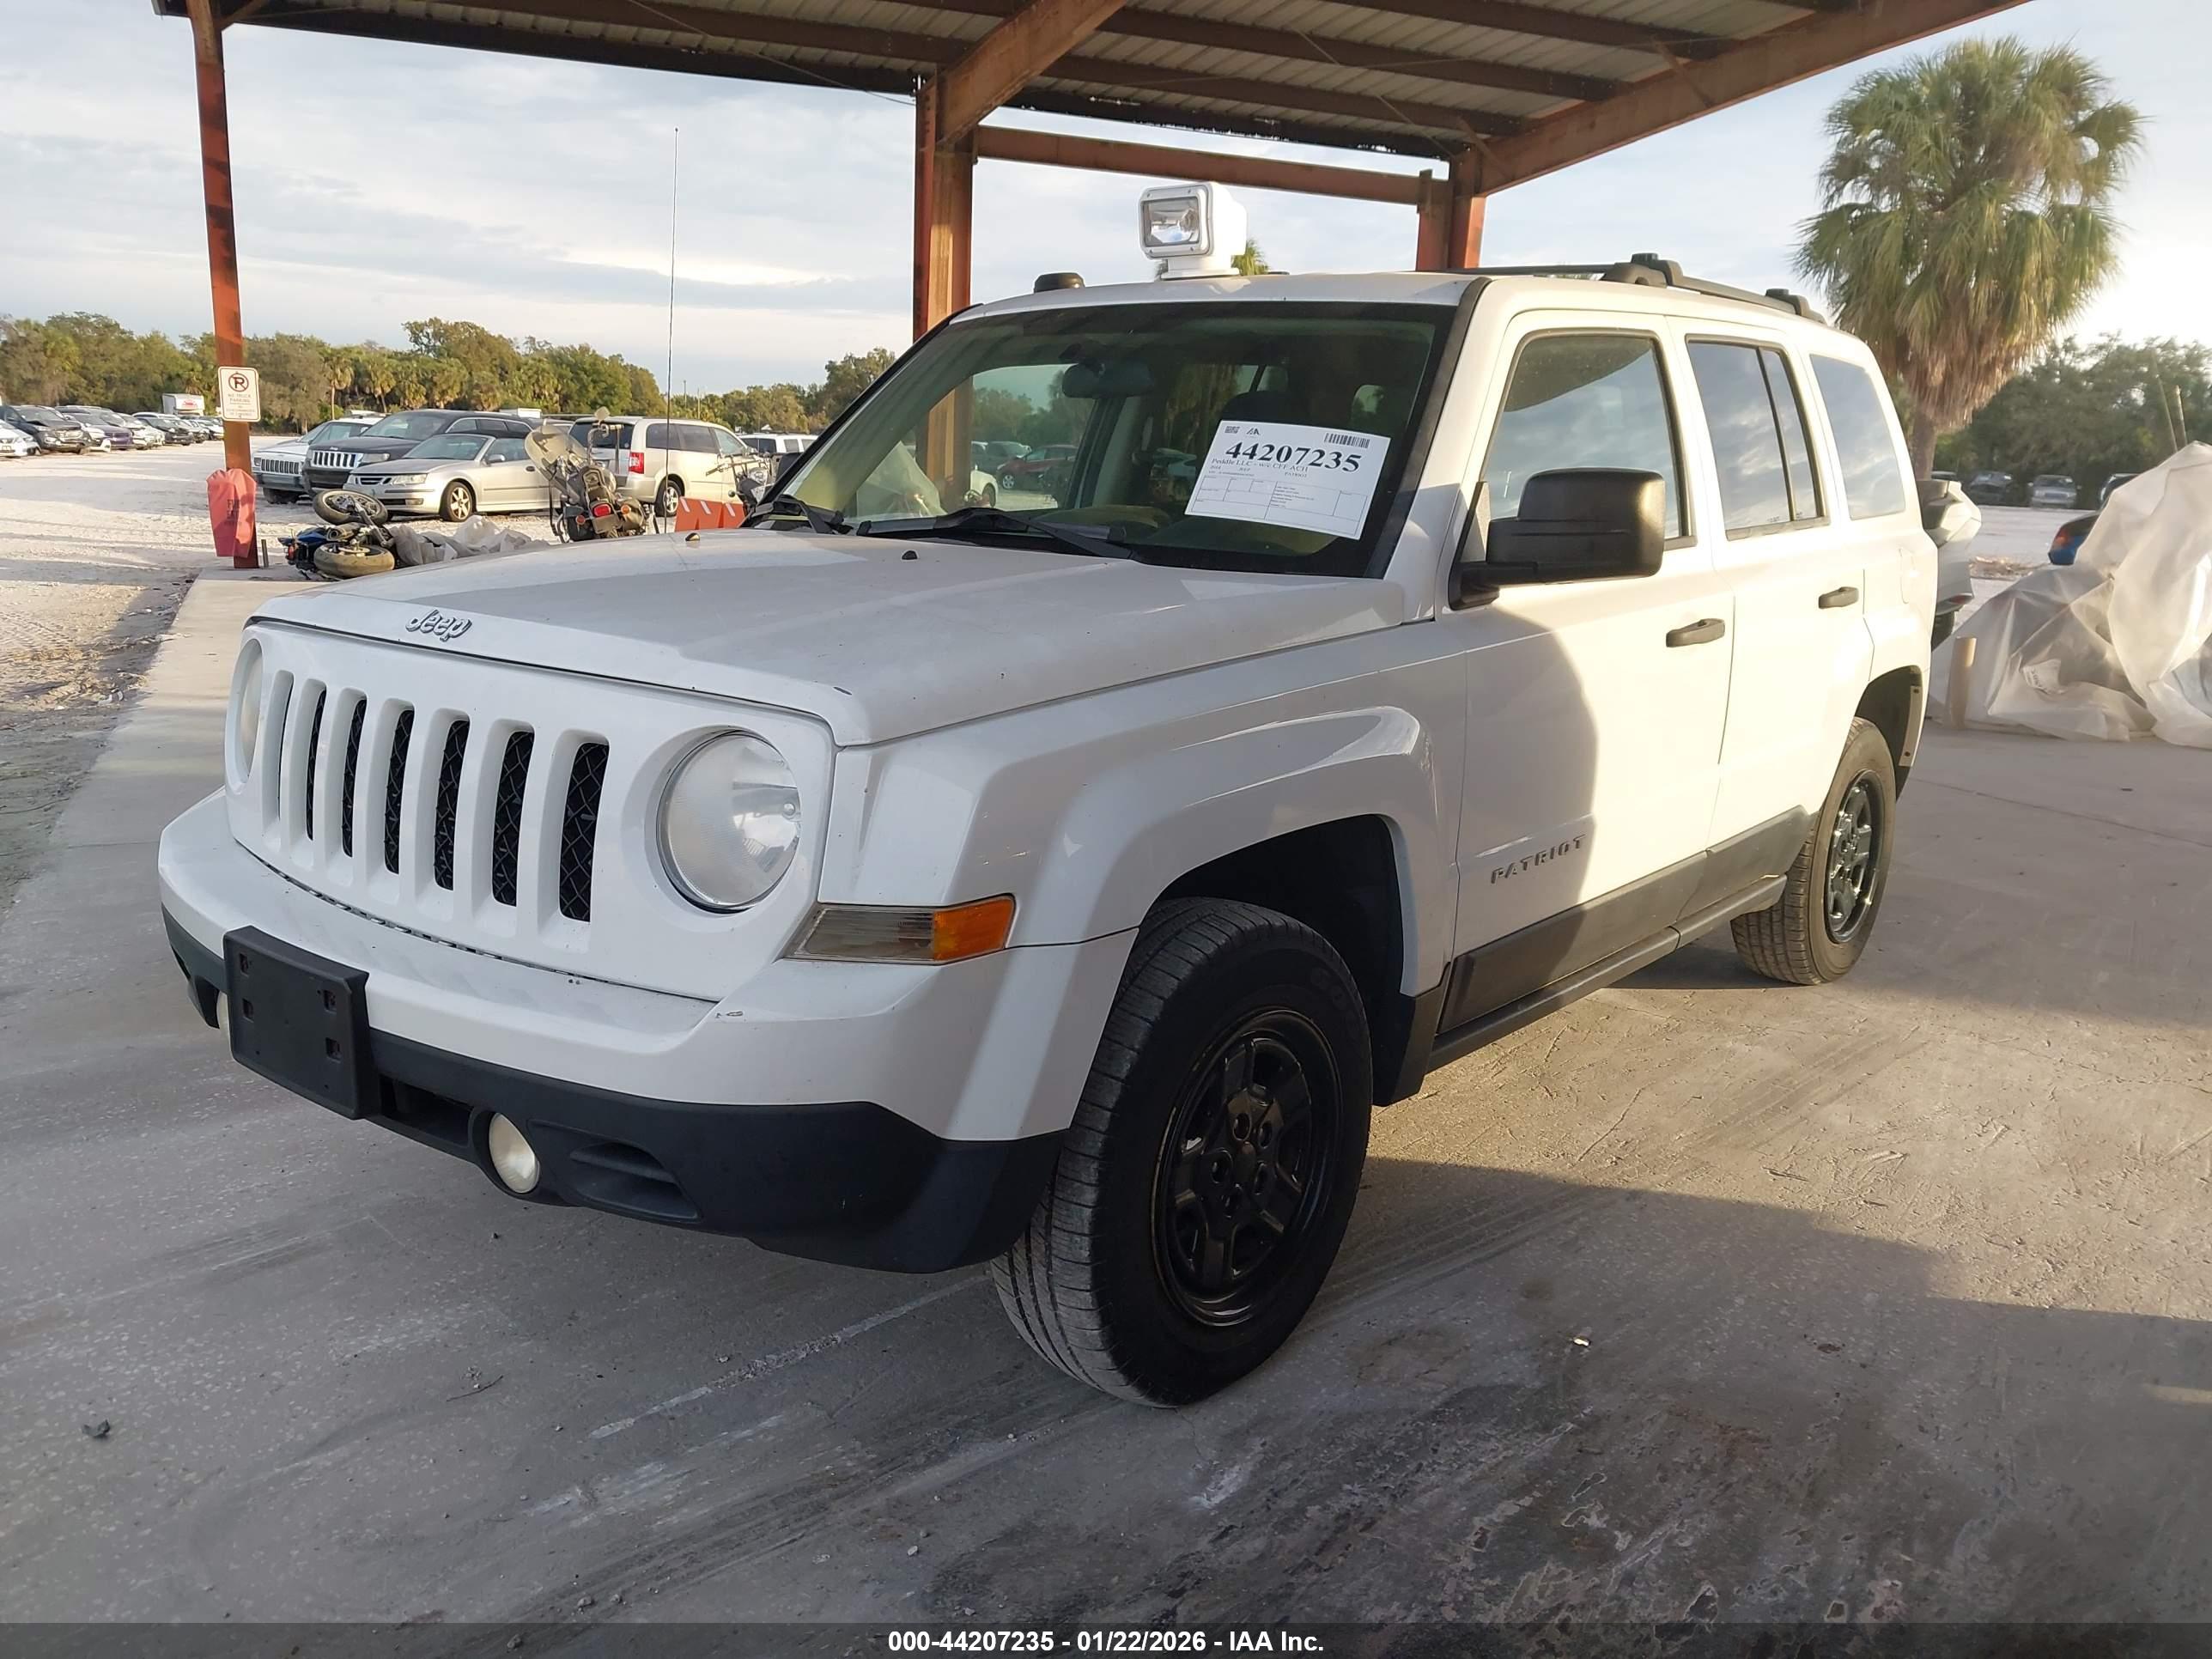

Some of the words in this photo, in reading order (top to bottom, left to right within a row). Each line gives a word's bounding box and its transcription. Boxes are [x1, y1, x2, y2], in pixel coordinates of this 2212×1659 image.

[1225, 441, 1362, 472] 44207235
[405, 609, 472, 642] Jeep
[1491, 833, 1586, 884] PATRIOT
